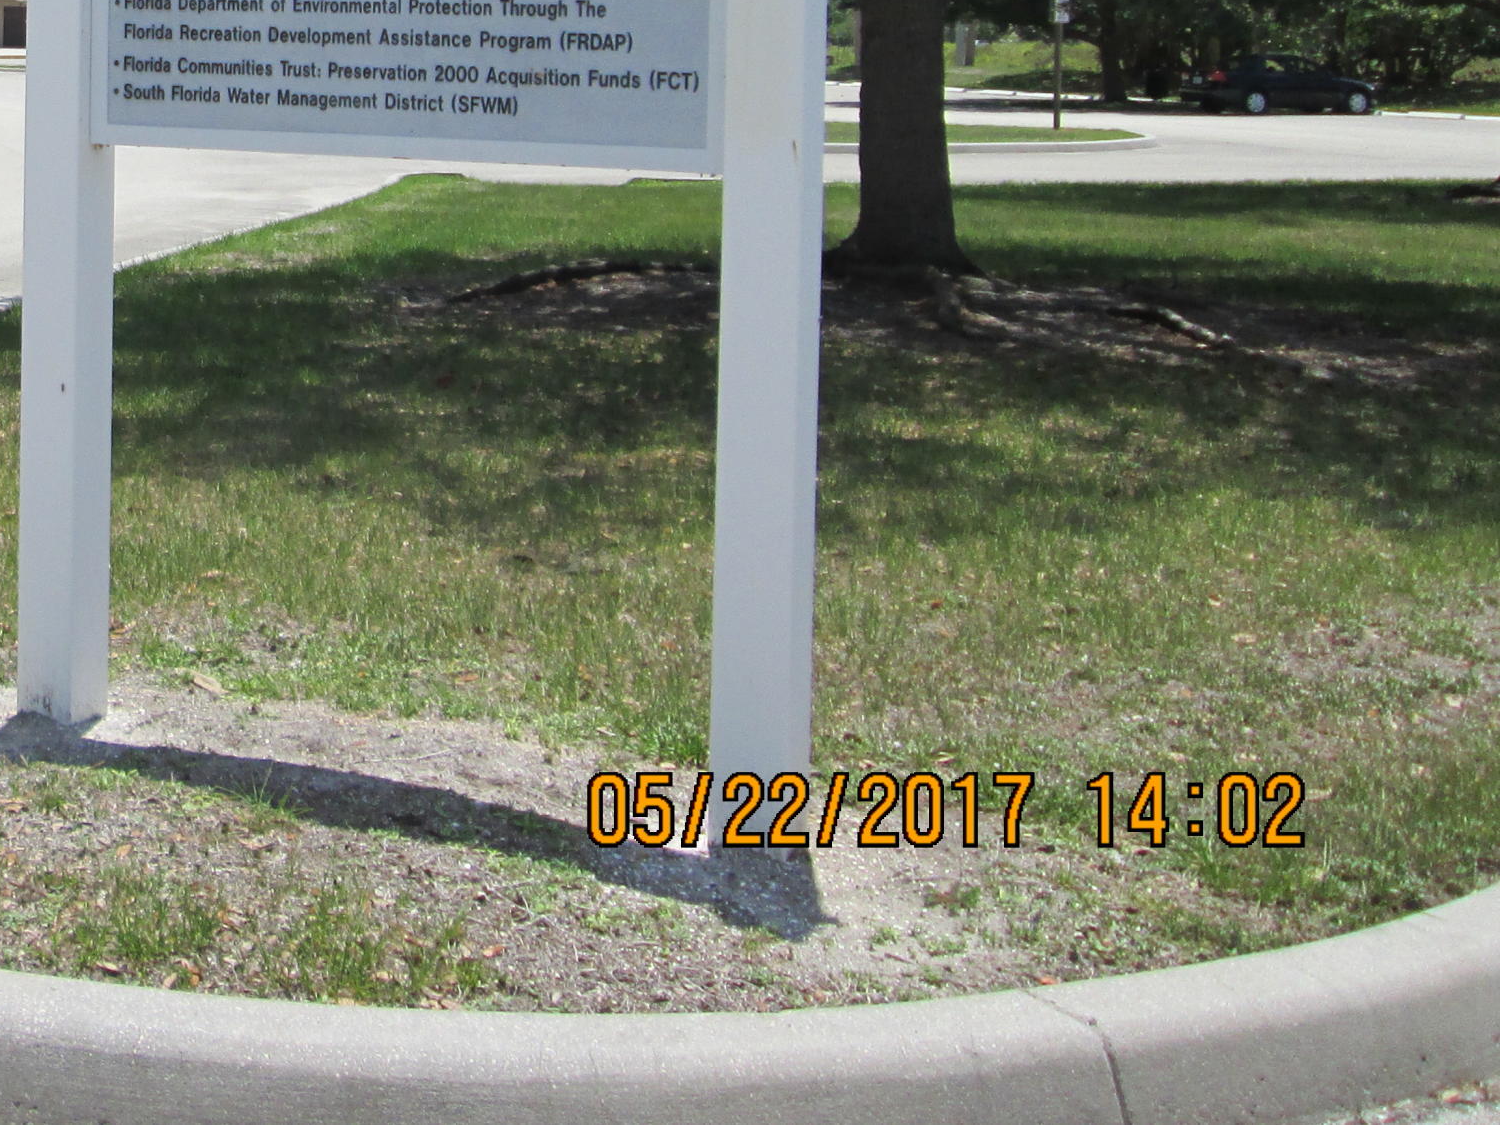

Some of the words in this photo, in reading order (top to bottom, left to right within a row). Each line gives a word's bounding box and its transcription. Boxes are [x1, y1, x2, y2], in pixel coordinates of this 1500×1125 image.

[500, 0, 568, 21] Through
[575, 0, 607, 18] The
[123, 23, 173, 40] Florida
[179, 24, 262, 43] Recreation
[268, 26, 371, 47] Development
[379, 28, 471, 47] Assistance
[480, 30, 551, 53] Program
[559, 31, 634, 53] (FRDAP)
[123, 55, 171, 73] Florida
[177, 57, 273, 77] Communities
[280, 60, 322, 78] Trust:
[327, 62, 427, 82] Preservation
[434, 65, 479, 84] 2000
[486, 67, 581, 88] Acquisition
[588, 69, 641, 88] Funds
[649, 70, 700, 93] (FCT)
[123, 83, 165, 101] South
[171, 85, 221, 103] Florida
[227, 87, 270, 105] Water
[277, 89, 377, 111] Management
[384, 92, 444, 112] District
[451, 95, 518, 116] (SFWM)
